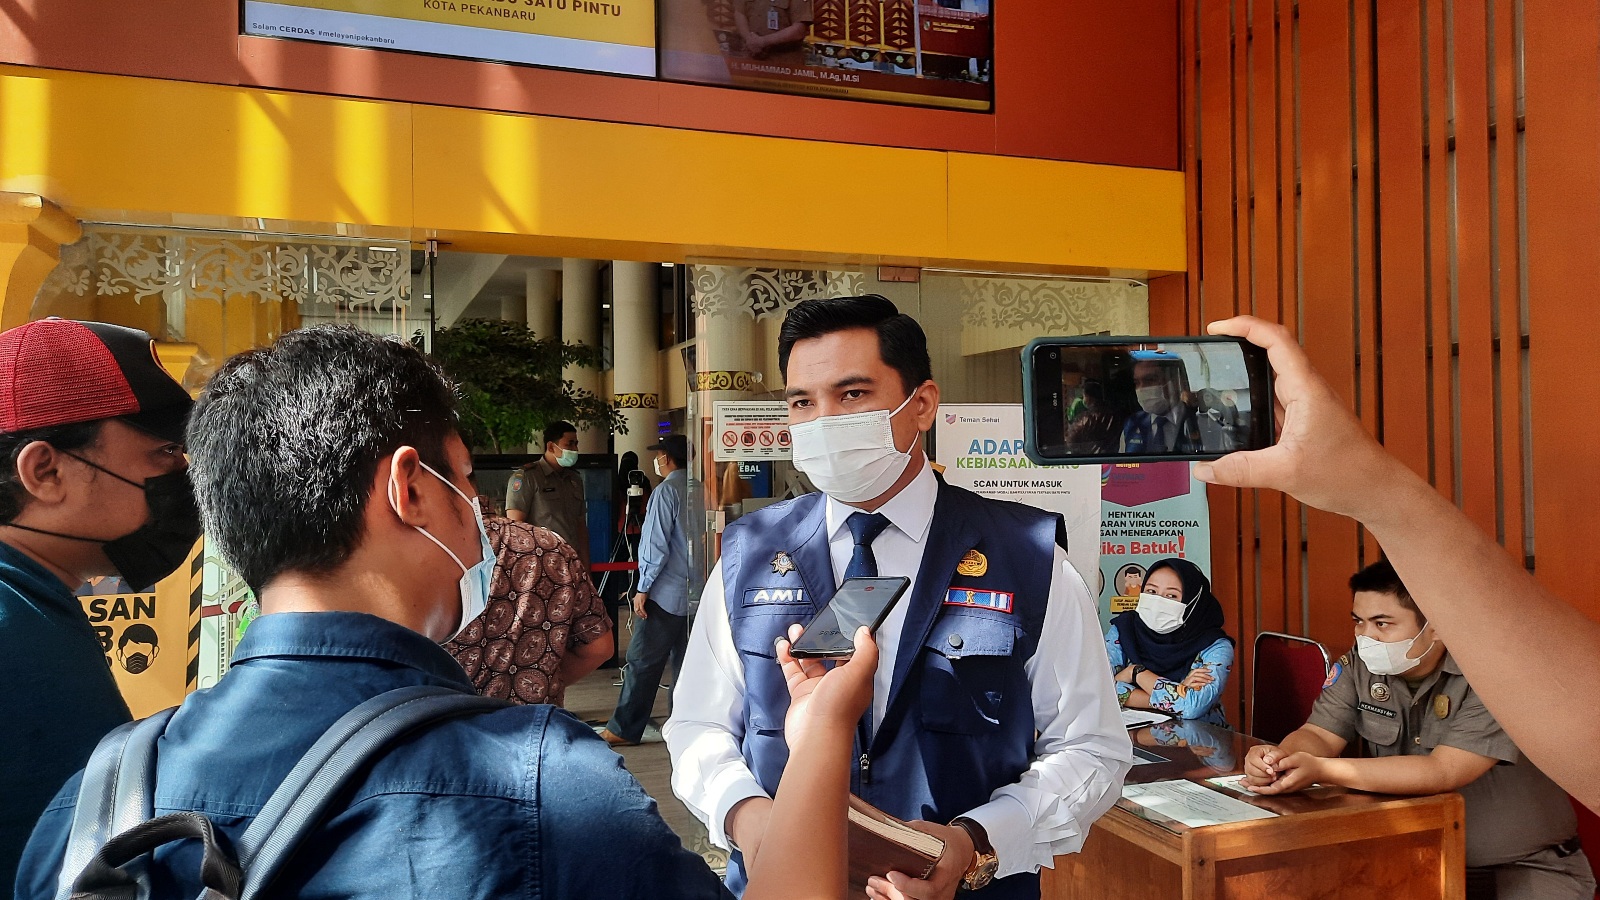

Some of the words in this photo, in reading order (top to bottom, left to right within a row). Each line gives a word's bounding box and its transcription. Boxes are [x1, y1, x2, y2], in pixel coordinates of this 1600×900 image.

[423, 0, 457, 11] KOTA
[461, 4, 536, 21] PEKANBARU
[572, 0, 621, 17] PINTU
[253, 22, 277, 31] Salam
[279, 25, 316, 36] CERDAS
[318, 30, 395, 44] #melayanipekanbaru
[741, 63, 791, 76] MUHAMMAD
[792, 68, 818, 79] JAMIL,
[843, 74, 860, 83] M.Si
[968, 439, 1024, 456] ADAP
[738, 465, 761, 473] EBAL
[973, 480, 998, 488] SCAN
[1000, 480, 1029, 488] UNTUK
[1031, 480, 1062, 488] MASUK
[1108, 511, 1155, 519] HENTIKAN
[1100, 520, 1127, 528] ARAN
[1129, 520, 1157, 528] VIRUS
[1159, 520, 1200, 528] CORONA
[1120, 529, 1184, 537] MENERAPKAN
[1100, 541, 1126, 555] ika
[1130, 536, 1186, 558] Batuk!
[754, 589, 803, 603] AMI
[88, 596, 156, 622] SAN
